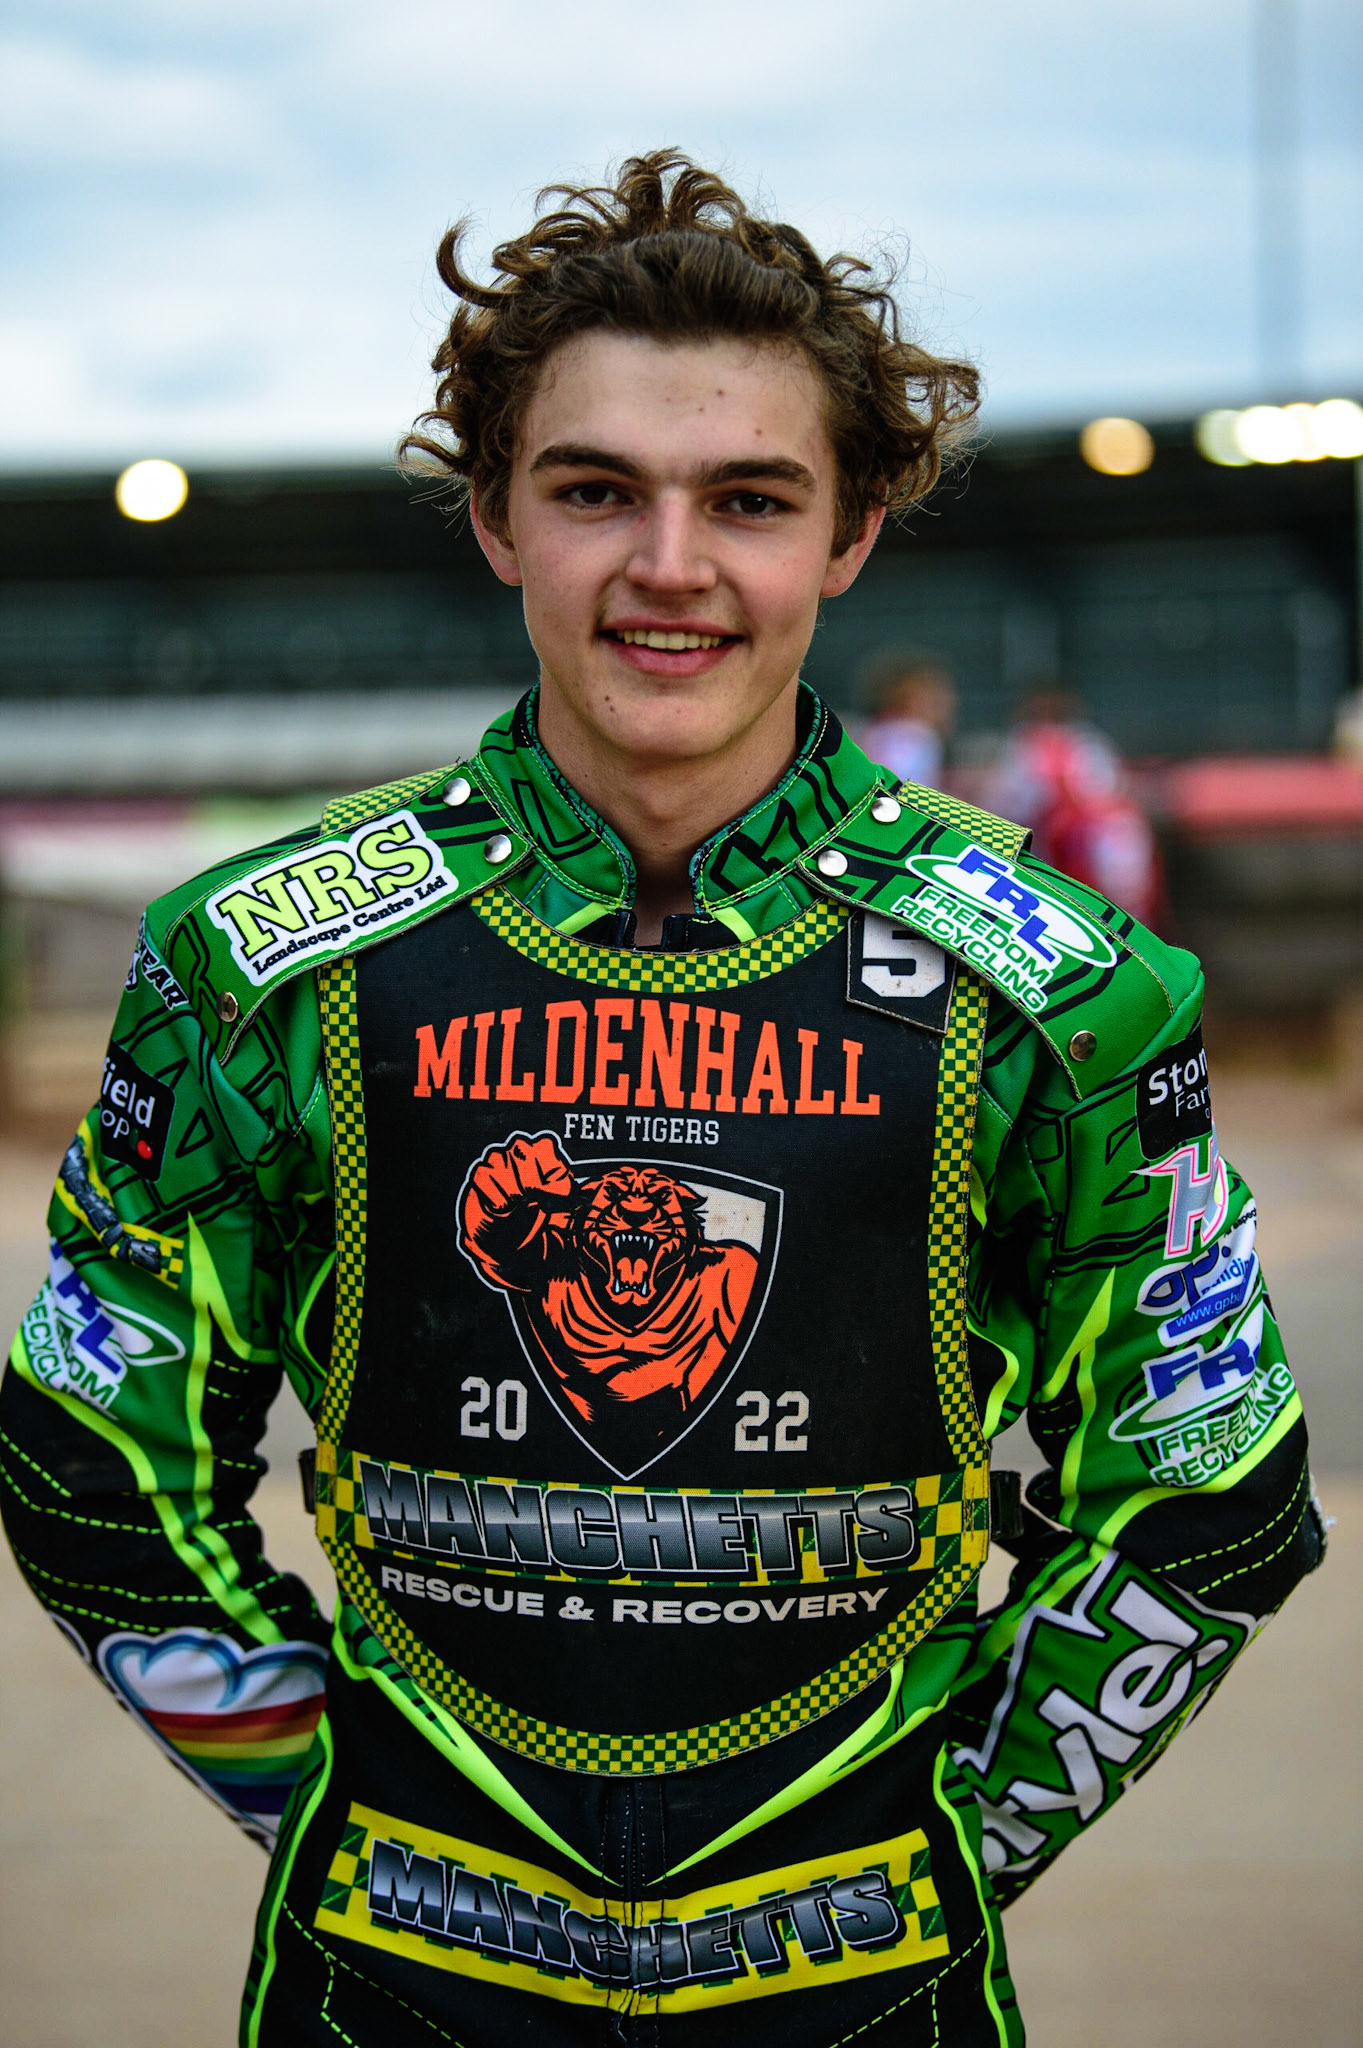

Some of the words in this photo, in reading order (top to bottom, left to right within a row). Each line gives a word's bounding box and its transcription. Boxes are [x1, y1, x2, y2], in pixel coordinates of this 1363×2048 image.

[217, 819, 433, 961] NRS
[253, 921, 351, 976] Landscape
[352, 896, 415, 929] Centre
[415, 875, 448, 901] Ltd
[918, 888, 1051, 985] FREEDOM
[957, 847, 1056, 963] FRL
[861, 914, 946, 998] 5
[893, 896, 1045, 1011] RECYCLING
[413, 998, 881, 1116] MILDENHALL
[564, 1113, 614, 1141] FEN
[626, 1115, 720, 1146] TIGERS
[460, 1375, 528, 1442] 20
[734, 1390, 810, 1452] 22
[1154, 1366, 1292, 1487] RECYCLING
[358, 1457, 914, 1572] MANCHETTS
[381, 1565, 545, 1617] RESCUE
[557, 1595, 596, 1622] &
[611, 1587, 890, 1626] RECOVERY
[974, 1579, 1230, 1872] tyle!
[367, 1837, 899, 1990] MANCHETTS
